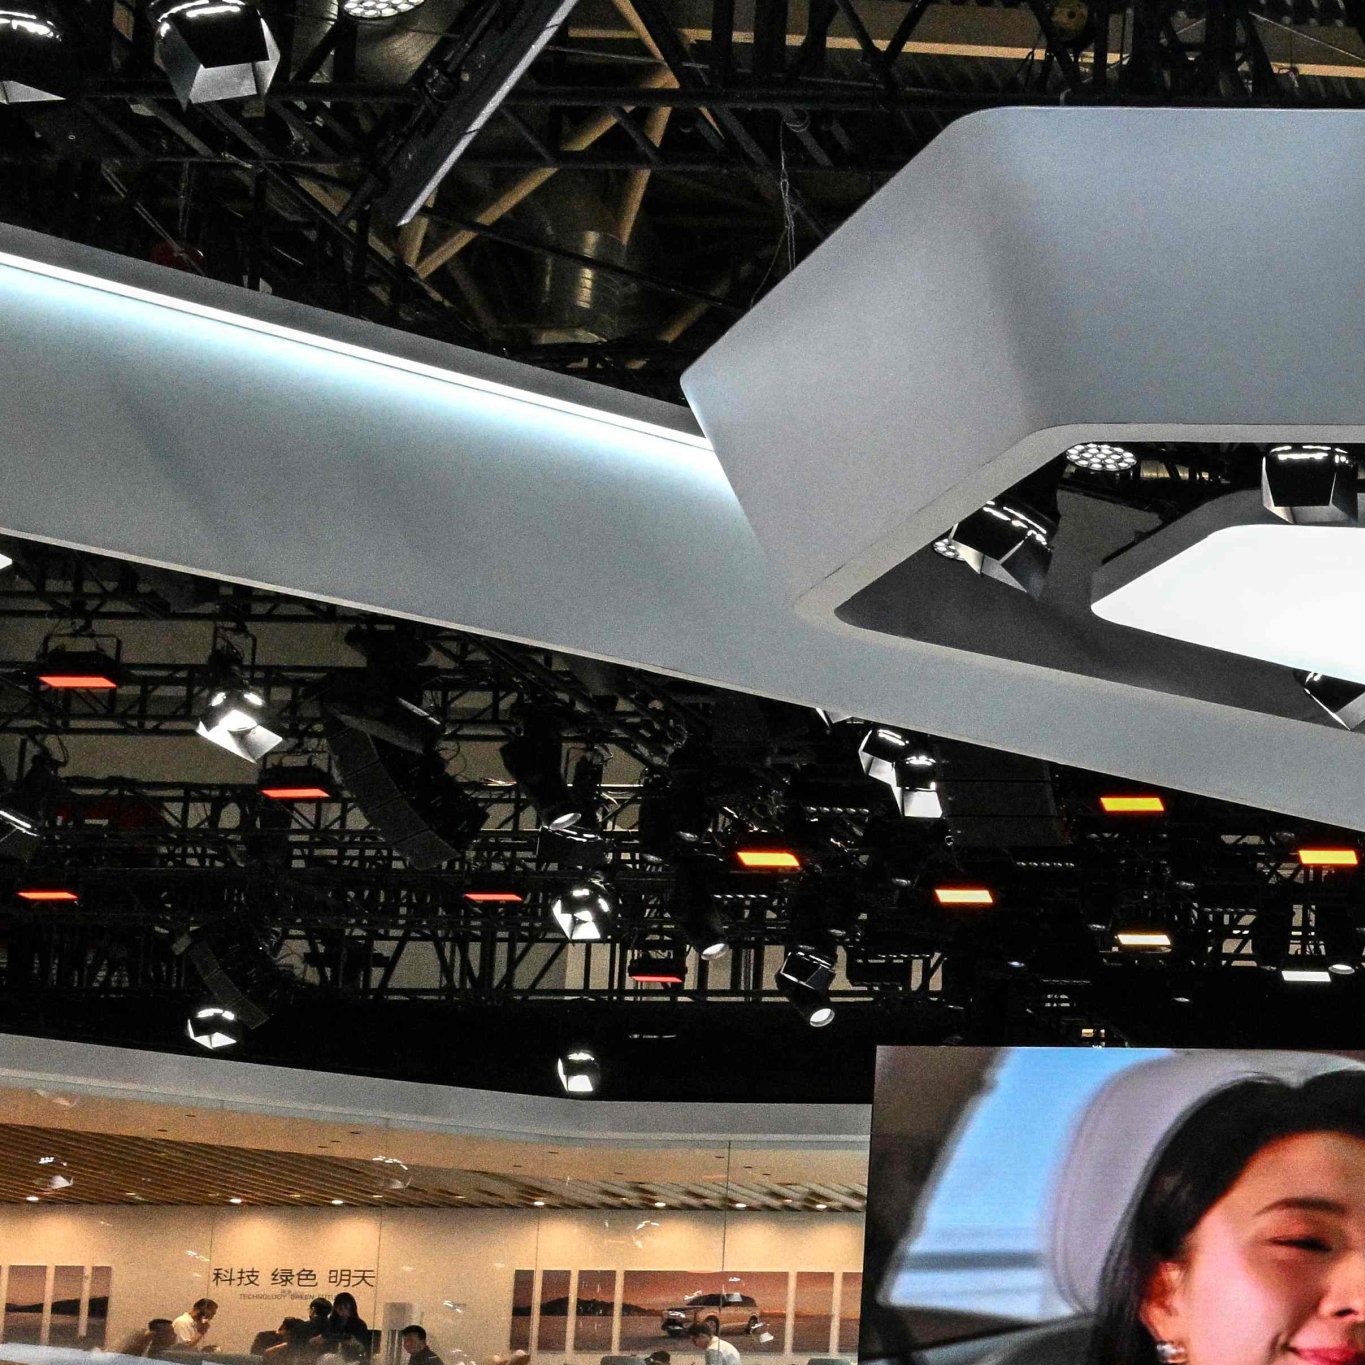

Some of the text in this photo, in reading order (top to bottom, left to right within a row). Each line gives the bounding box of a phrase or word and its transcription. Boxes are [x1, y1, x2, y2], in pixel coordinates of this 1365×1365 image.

[212, 1267, 376, 1288] 科技 绿色 明天
